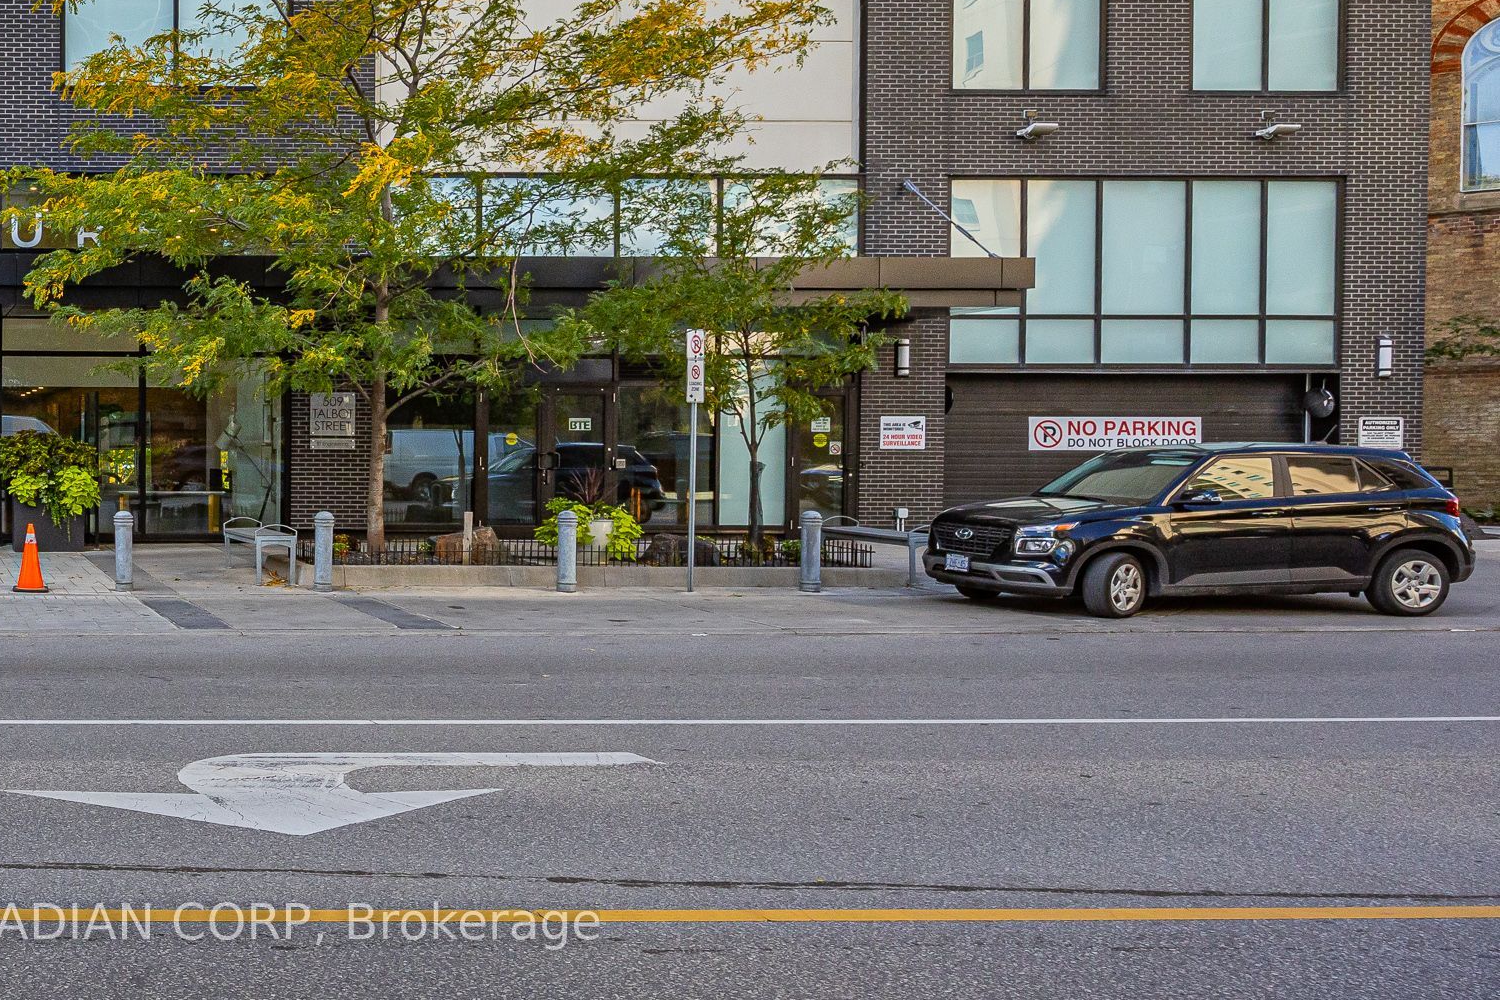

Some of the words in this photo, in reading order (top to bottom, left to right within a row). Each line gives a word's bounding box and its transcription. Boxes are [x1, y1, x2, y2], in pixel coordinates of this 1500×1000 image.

[312, 408, 354, 419] TALBOT
[314, 420, 352, 431] STREET
[569, 420, 591, 430] BTE
[1067, 420, 1098, 436] NO
[1104, 420, 1197, 436] PARKING
[1067, 438, 1085, 448] DO
[1088, 438, 1114, 448] NOT
[1116, 438, 1158, 448] BLOCK
